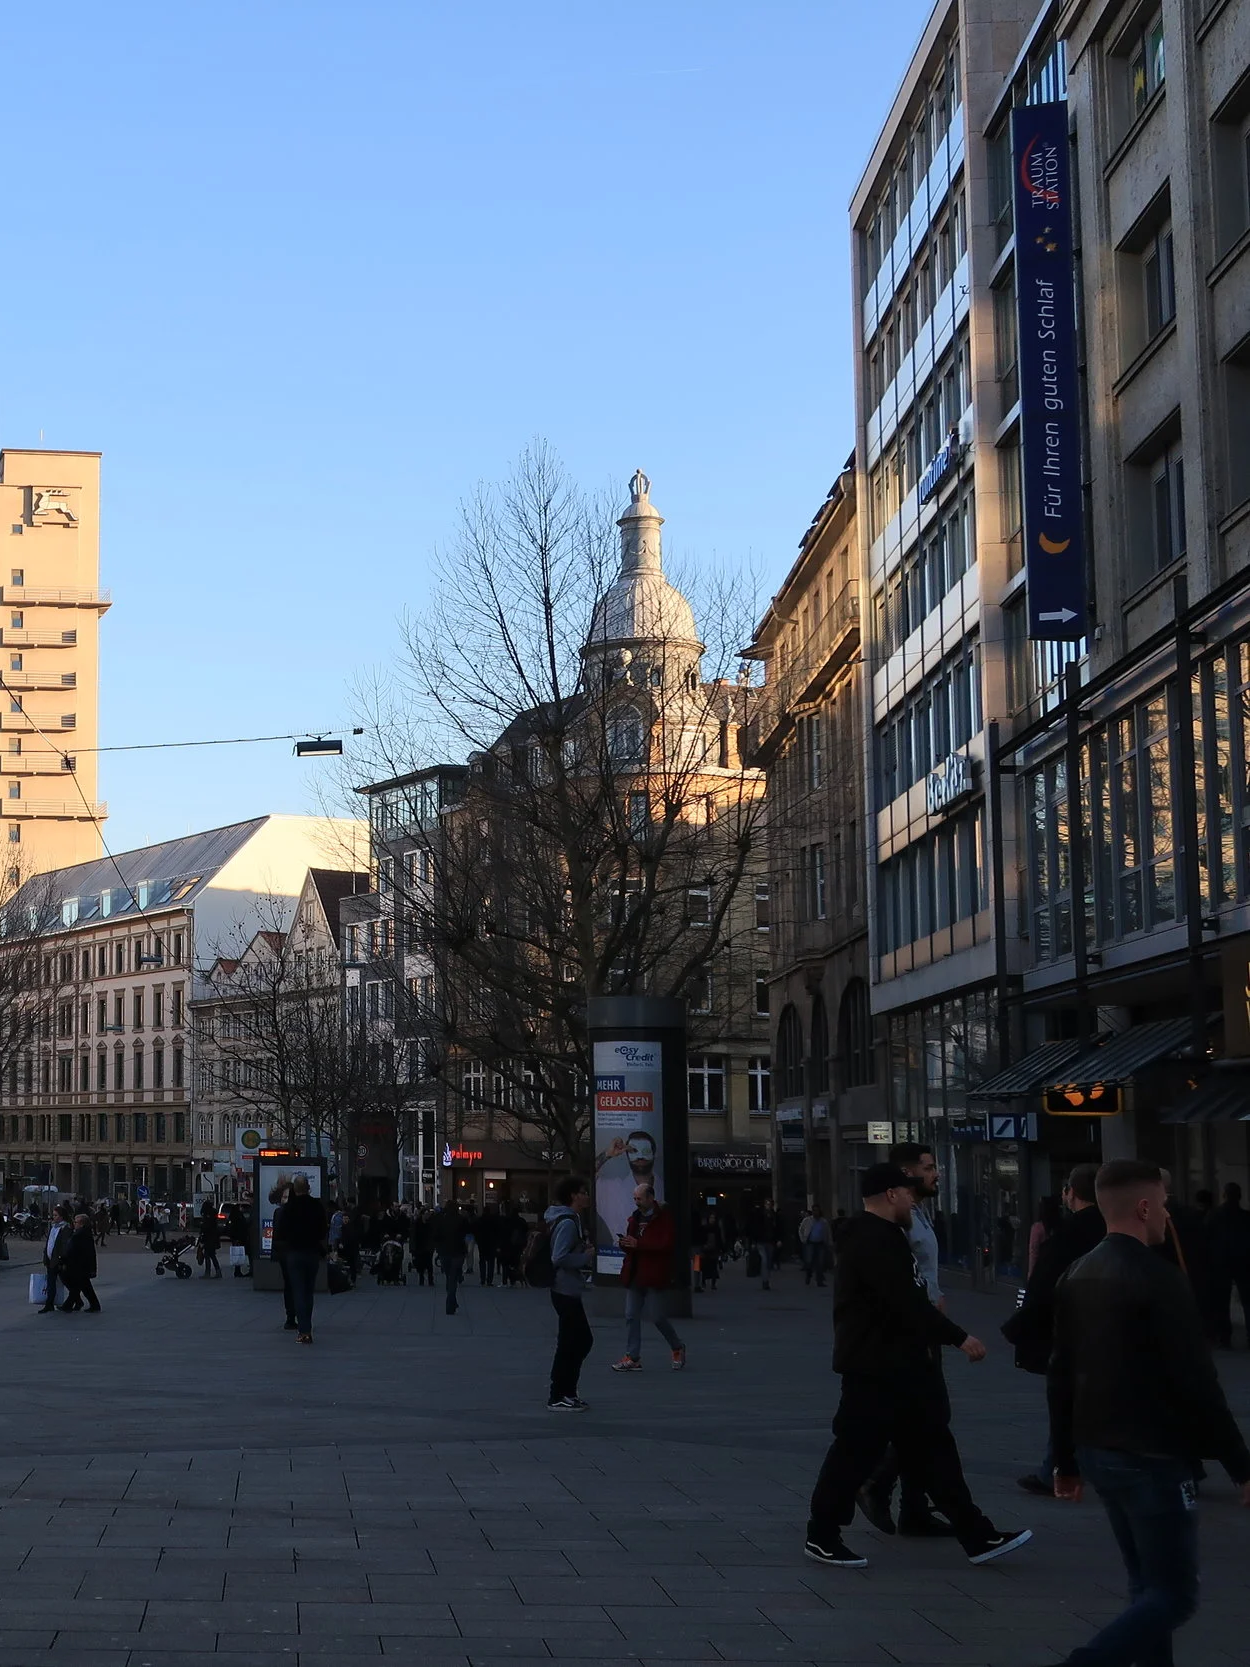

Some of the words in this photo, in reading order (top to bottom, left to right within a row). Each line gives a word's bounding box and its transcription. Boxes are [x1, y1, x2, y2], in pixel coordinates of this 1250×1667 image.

[1031, 152, 1045, 209] TRAUM
[1044, 146, 1060, 210] STATION
[1035, 277, 1056, 340] Schlaf
[1041, 350, 1064, 411] guten
[1042, 421, 1061, 477] Ihren
[1044, 483, 1063, 518] Für
[626, 1053, 655, 1062] Credit
[596, 1079, 621, 1091] MEHR
[600, 1096, 649, 1108] GELASSEN
[451, 1144, 483, 1167] Palmyra
